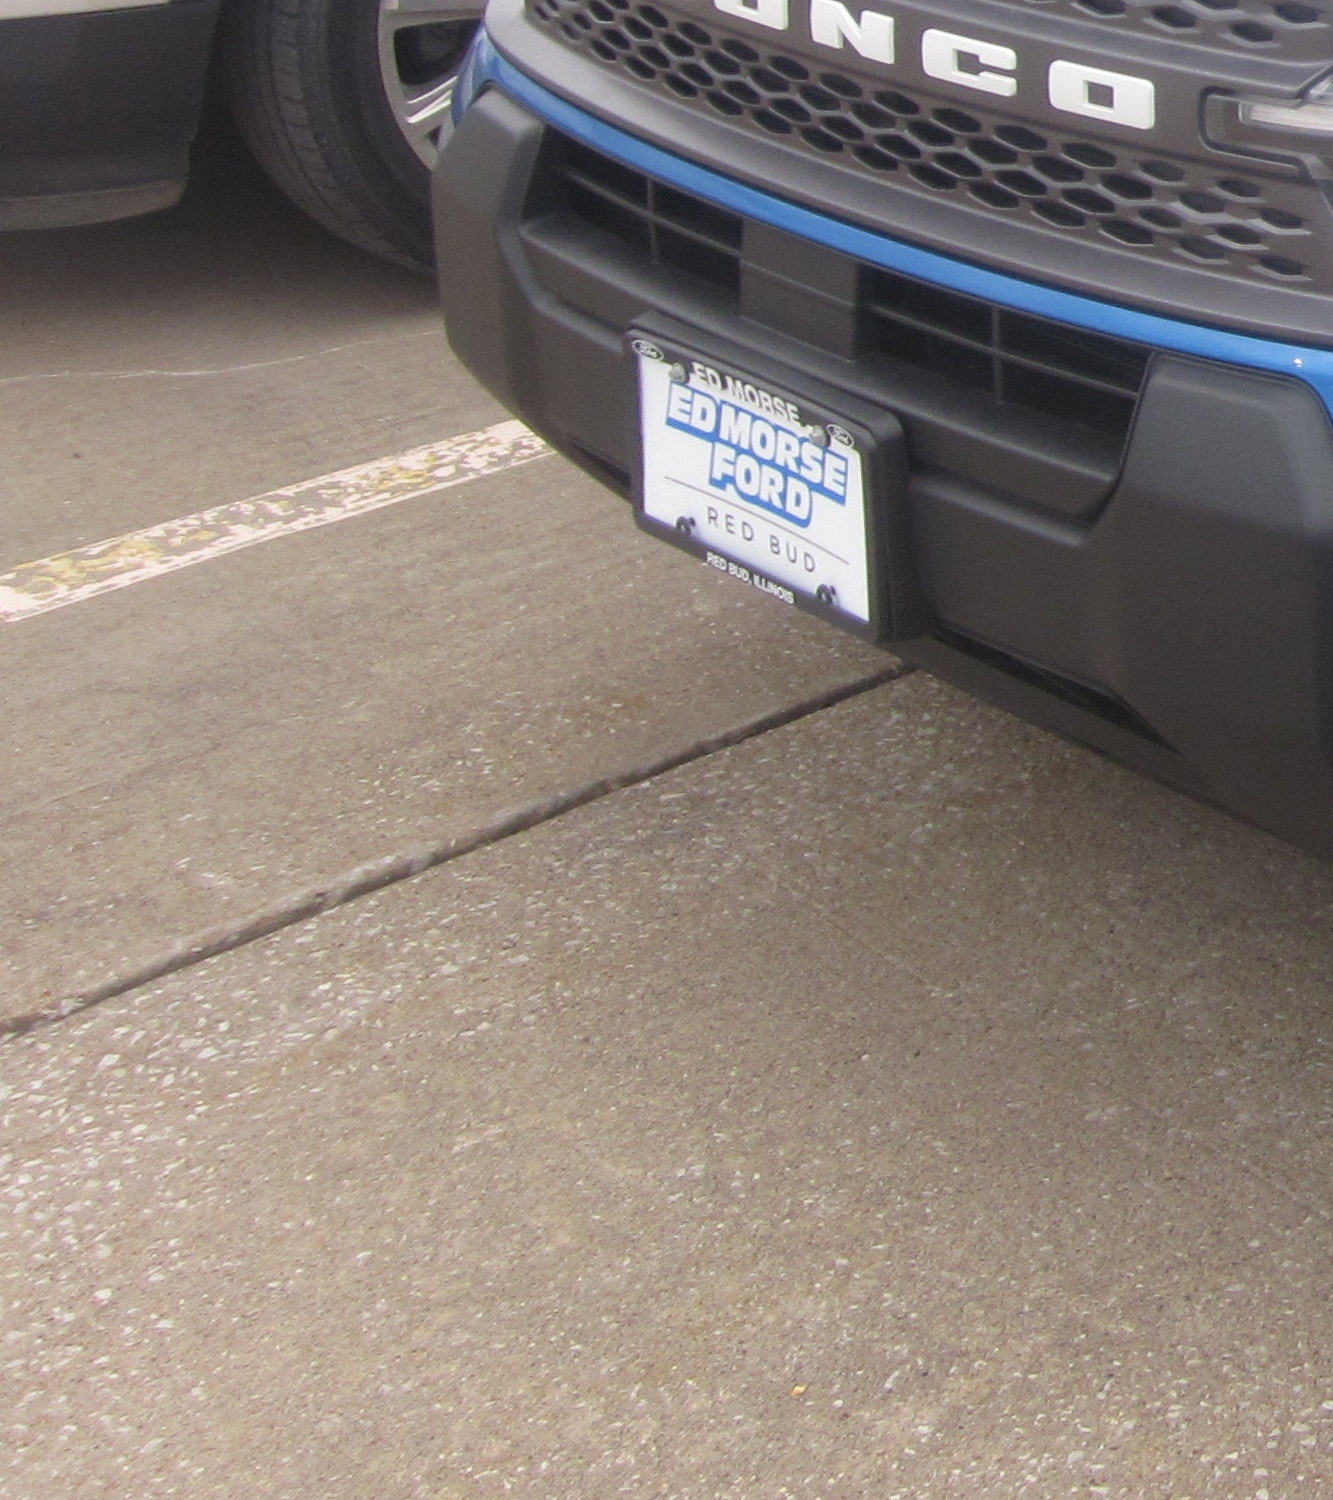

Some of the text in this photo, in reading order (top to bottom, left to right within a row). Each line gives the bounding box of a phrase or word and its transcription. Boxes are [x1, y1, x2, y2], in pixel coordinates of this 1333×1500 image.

[666, 382, 848, 500] ED MORSE
[710, 441, 813, 524] FORD
[706, 506, 817, 573] RED BUD
[706, 551, 728, 572] RED
[753, 573, 796, 605] ILLINOIS
